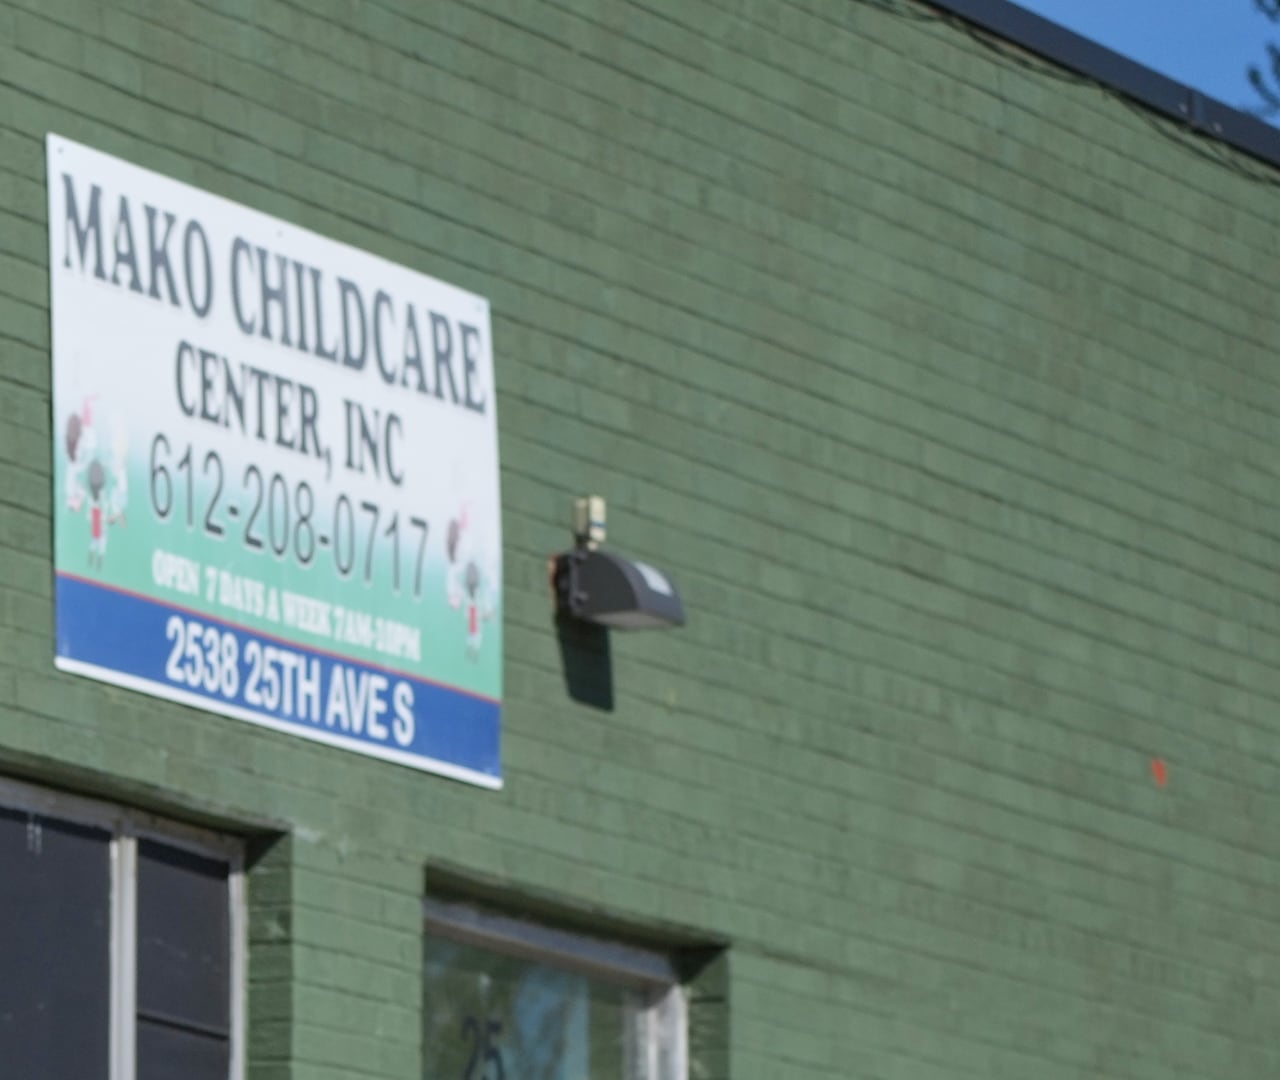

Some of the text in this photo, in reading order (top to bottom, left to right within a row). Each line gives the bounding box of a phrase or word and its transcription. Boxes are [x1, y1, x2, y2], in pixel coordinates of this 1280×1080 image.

[61, 173, 486, 415] MAKO CHILDCARE
[175, 340, 404, 486] CENTER, INC
[150, 432, 430, 598] 612-208-0717
[151, 549, 201, 597] OPEN
[204, 566, 218, 603] 7
[219, 570, 266, 620] DAYS
[266, 586, 281, 623] A
[281, 590, 333, 638] WEEK
[165, 615, 416, 747] 2538 25TH AVE S
